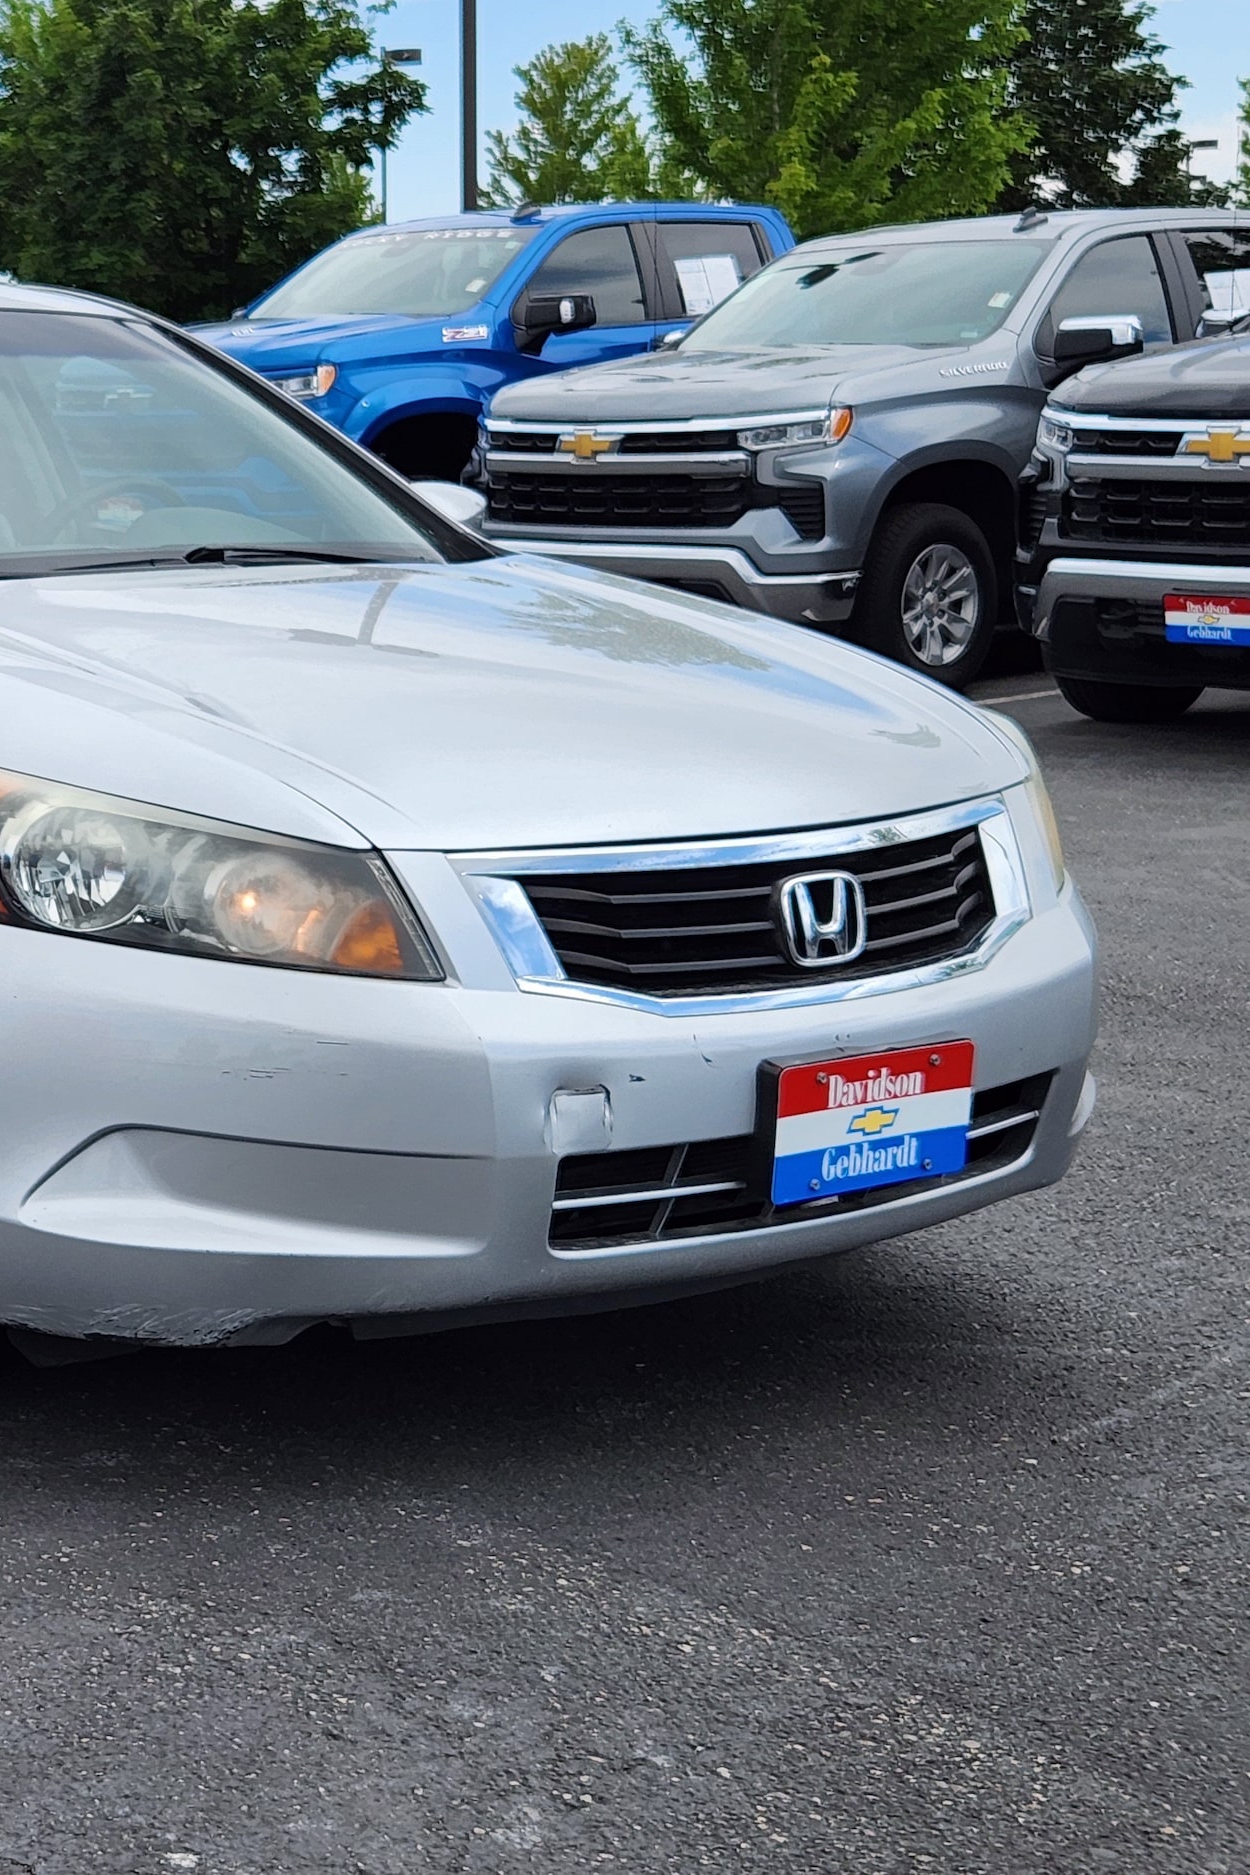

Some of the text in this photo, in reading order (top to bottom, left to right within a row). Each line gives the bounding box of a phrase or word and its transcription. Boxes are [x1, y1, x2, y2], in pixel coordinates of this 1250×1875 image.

[1186, 600, 1230, 614] Davidson
[826, 1067, 925, 1109] Davidson
[821, 1134, 918, 1182] Gebhardt
